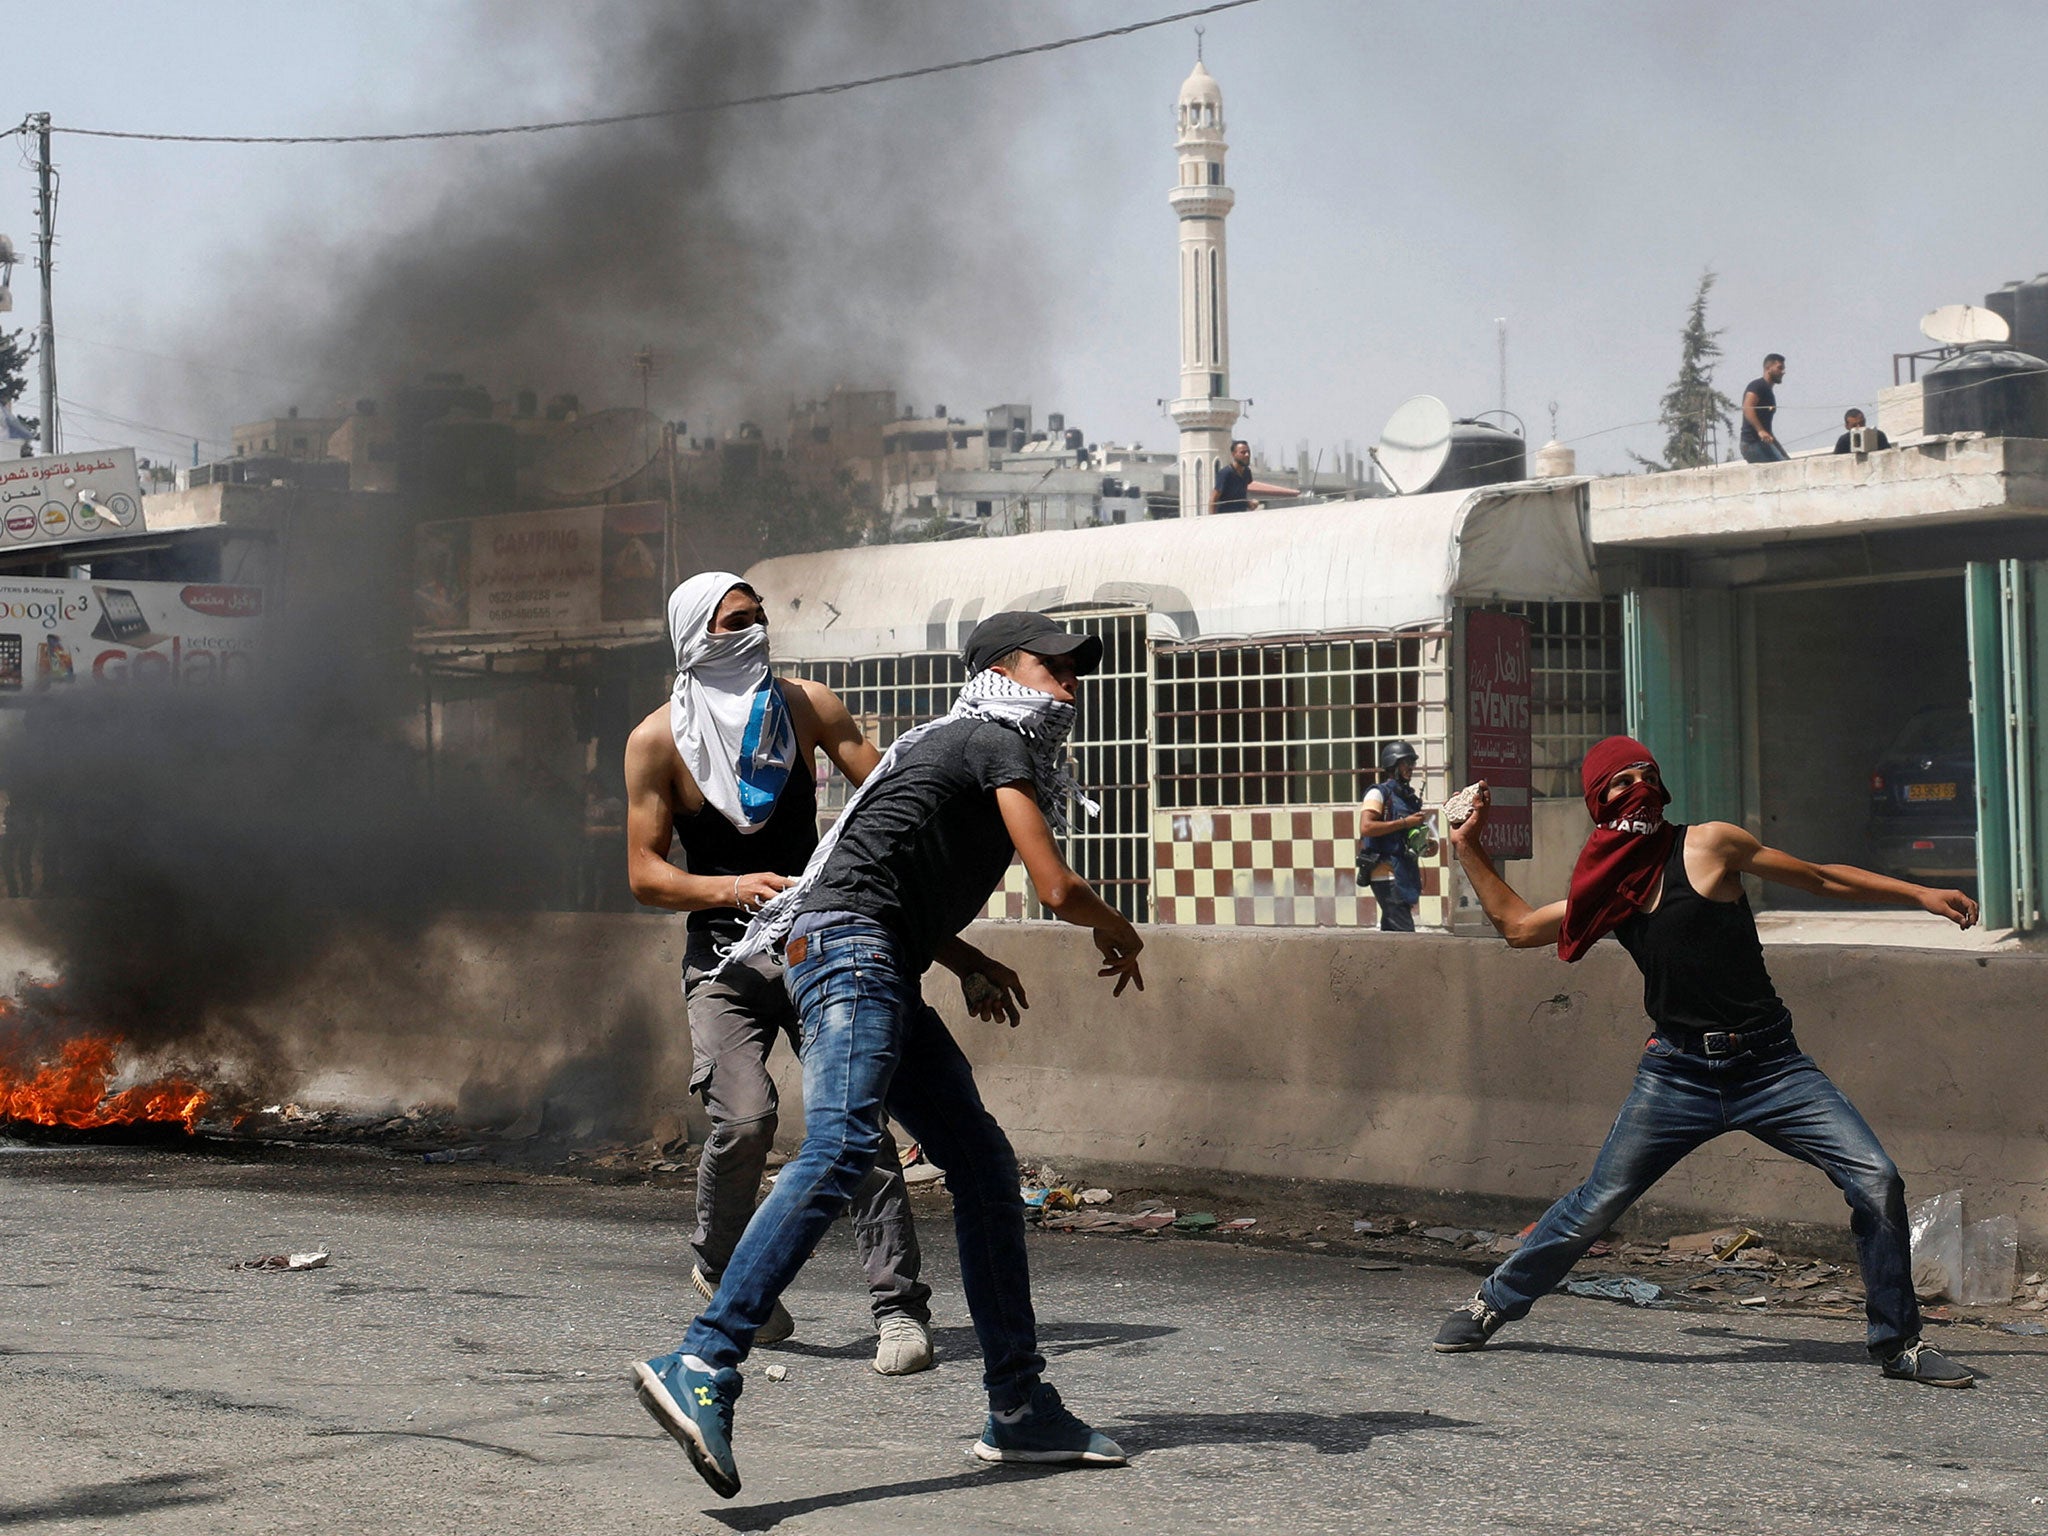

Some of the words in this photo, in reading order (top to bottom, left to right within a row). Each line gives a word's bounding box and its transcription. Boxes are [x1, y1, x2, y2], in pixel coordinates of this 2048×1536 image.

[31, 462, 71, 480] فاتورة
[73, 457, 116, 475] خطوط
[2, 485, 41, 503] شحن
[189, 593, 225, 606] معتمد
[227, 592, 257, 610] وكيل
[1470, 681, 1529, 729] EVENTS
